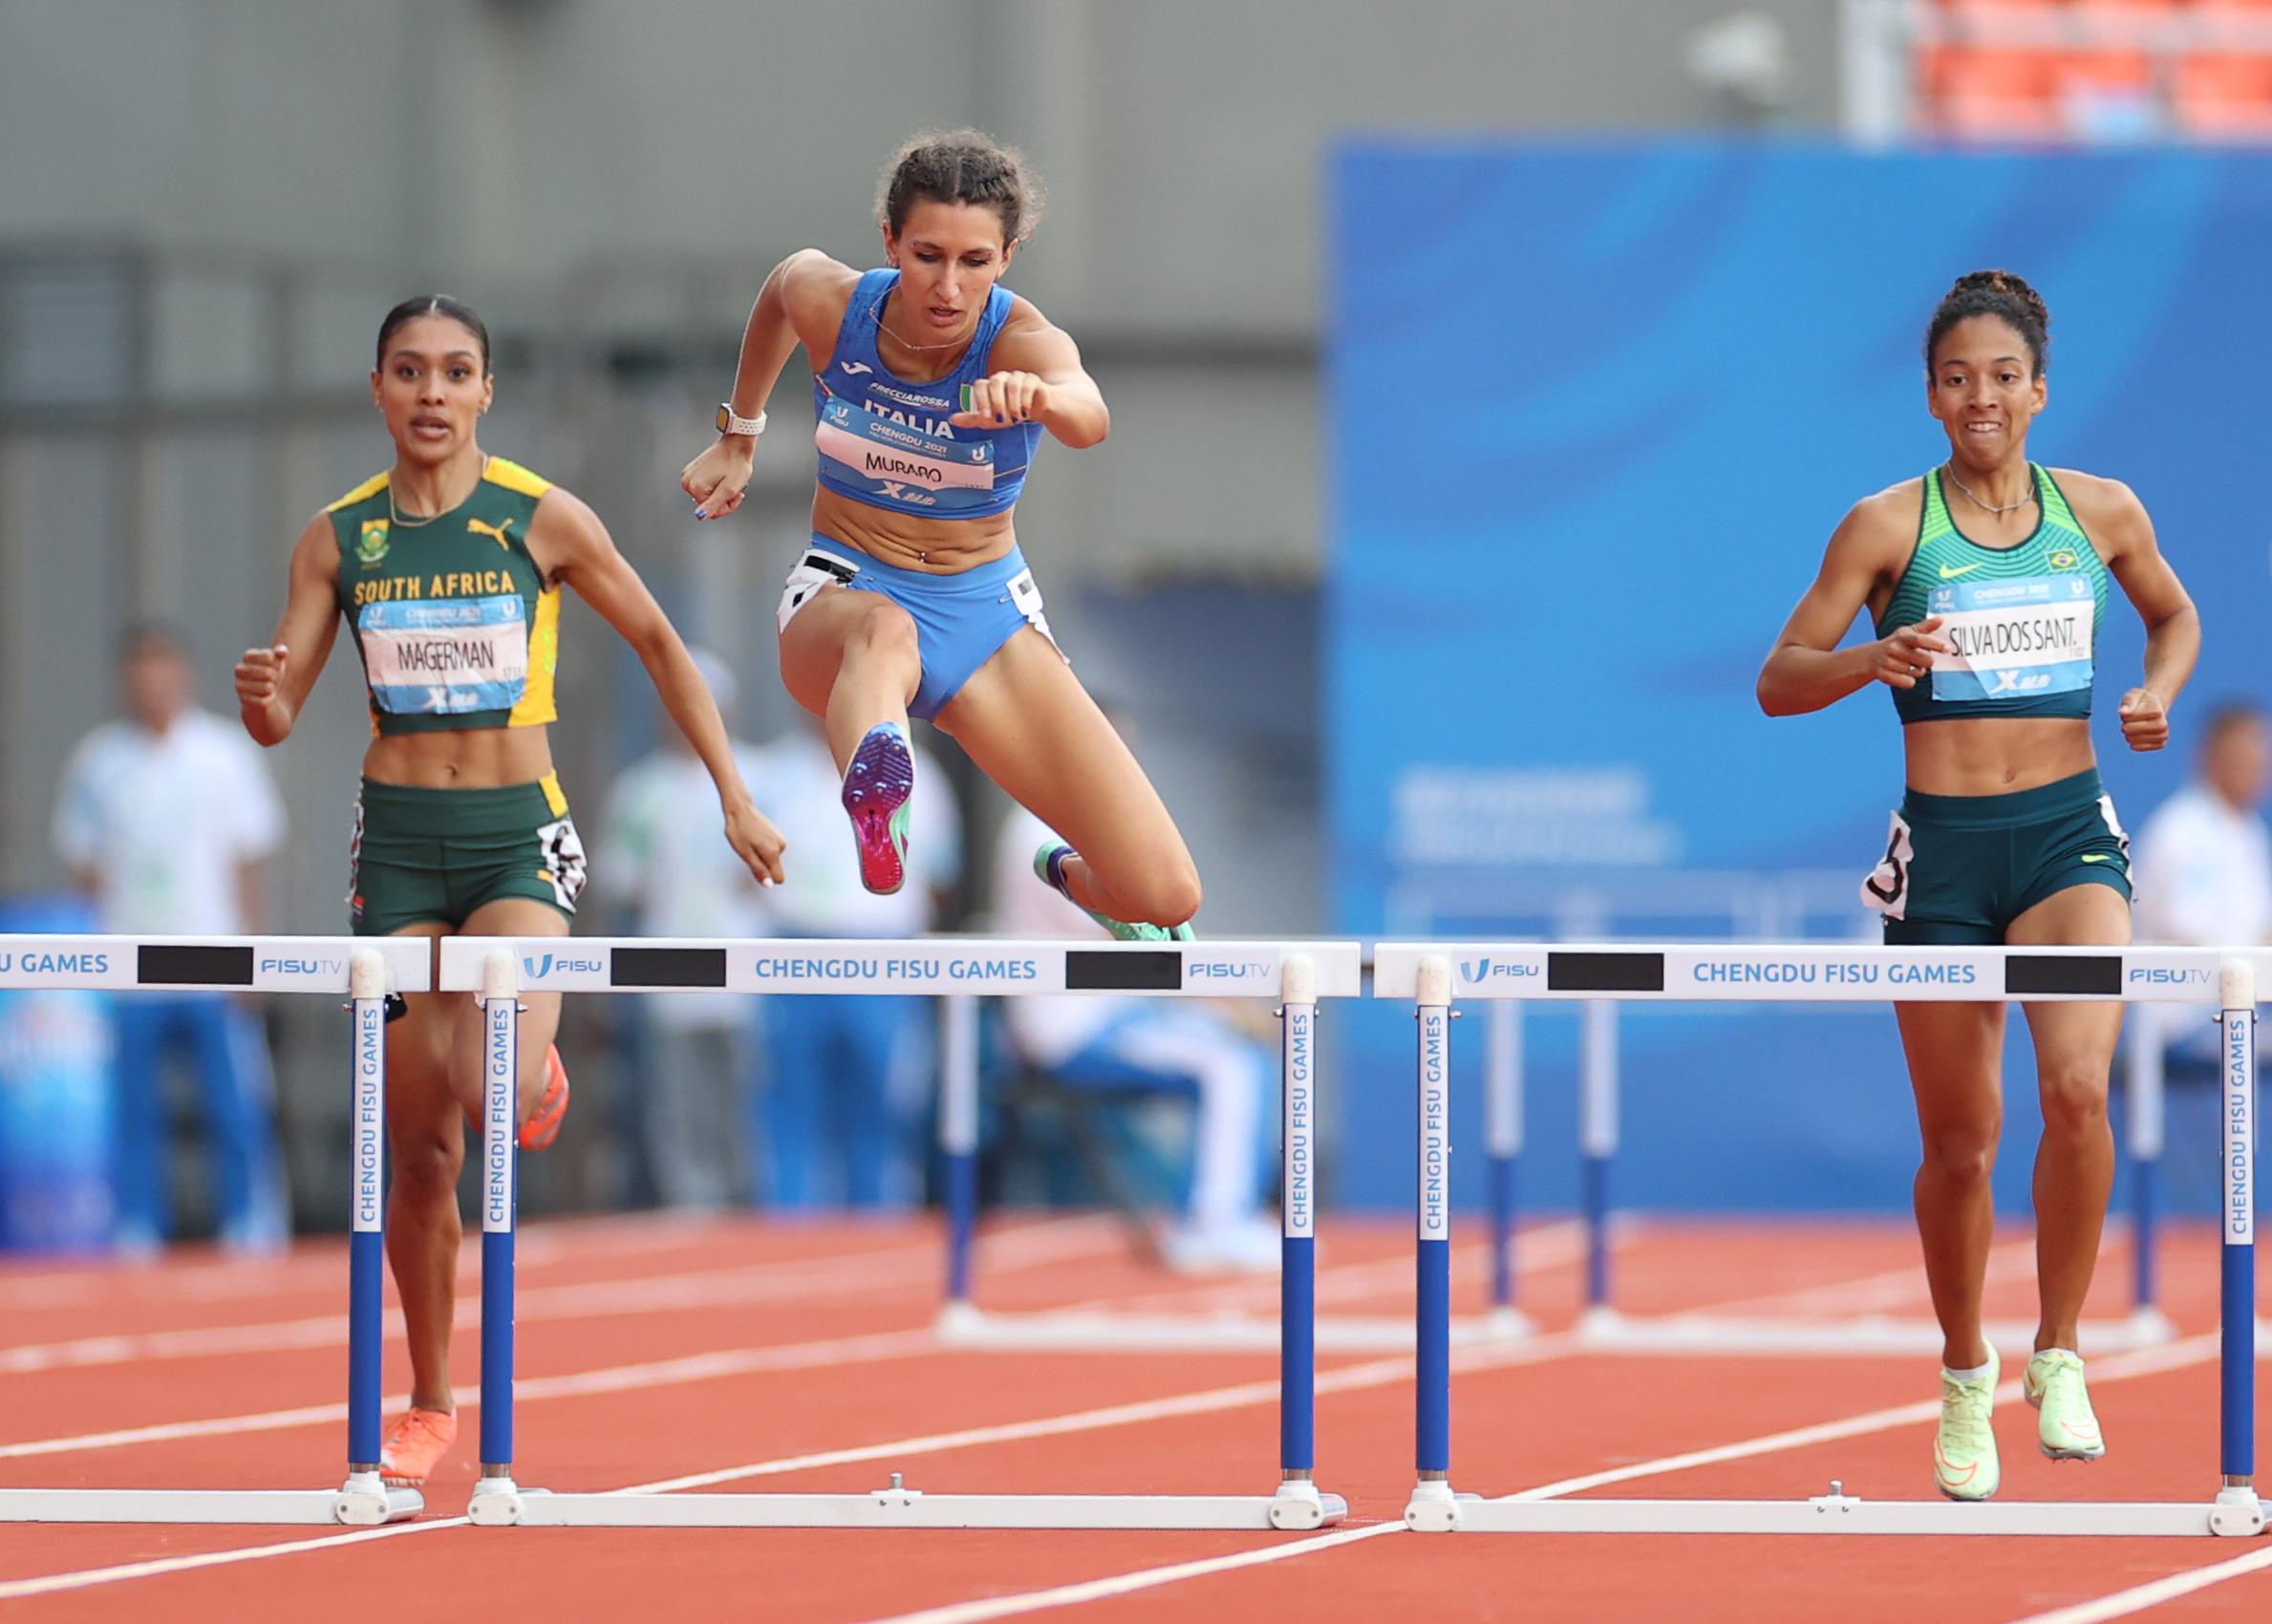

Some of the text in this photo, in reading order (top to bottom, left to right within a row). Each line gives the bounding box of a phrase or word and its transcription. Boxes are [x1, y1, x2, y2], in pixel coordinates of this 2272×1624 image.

[869, 382, 950, 409] FRECCIAROSSA
[864, 399, 954, 440] ITALIA
[870, 422, 922, 446] CHENGDU
[924, 441, 948, 454] 2021
[354, 570, 515, 606] SOUTH AFRICA
[397, 641, 494, 672] MAGERMAN
[21, 953, 108, 972] GAMES
[555, 960, 602, 972] FISU
[755, 958, 1037, 979] CHENGDU FISU GAMES
[1492, 964, 1539, 976] FISU
[1693, 962, 1976, 984] CHENGDU FISU GAMES
[361, 1009, 378, 1223] CHENGDU FISU GAMES
[489, 1009, 508, 1224] CHENGDU FISU GAMES
[1293, 1014, 1308, 1229] CHENGDU FISU GAMES
[1426, 1015, 1442, 1230] CHENGDU FISU GAMES
[2231, 1019, 2246, 1235] CHENGDU FISU GAMES
